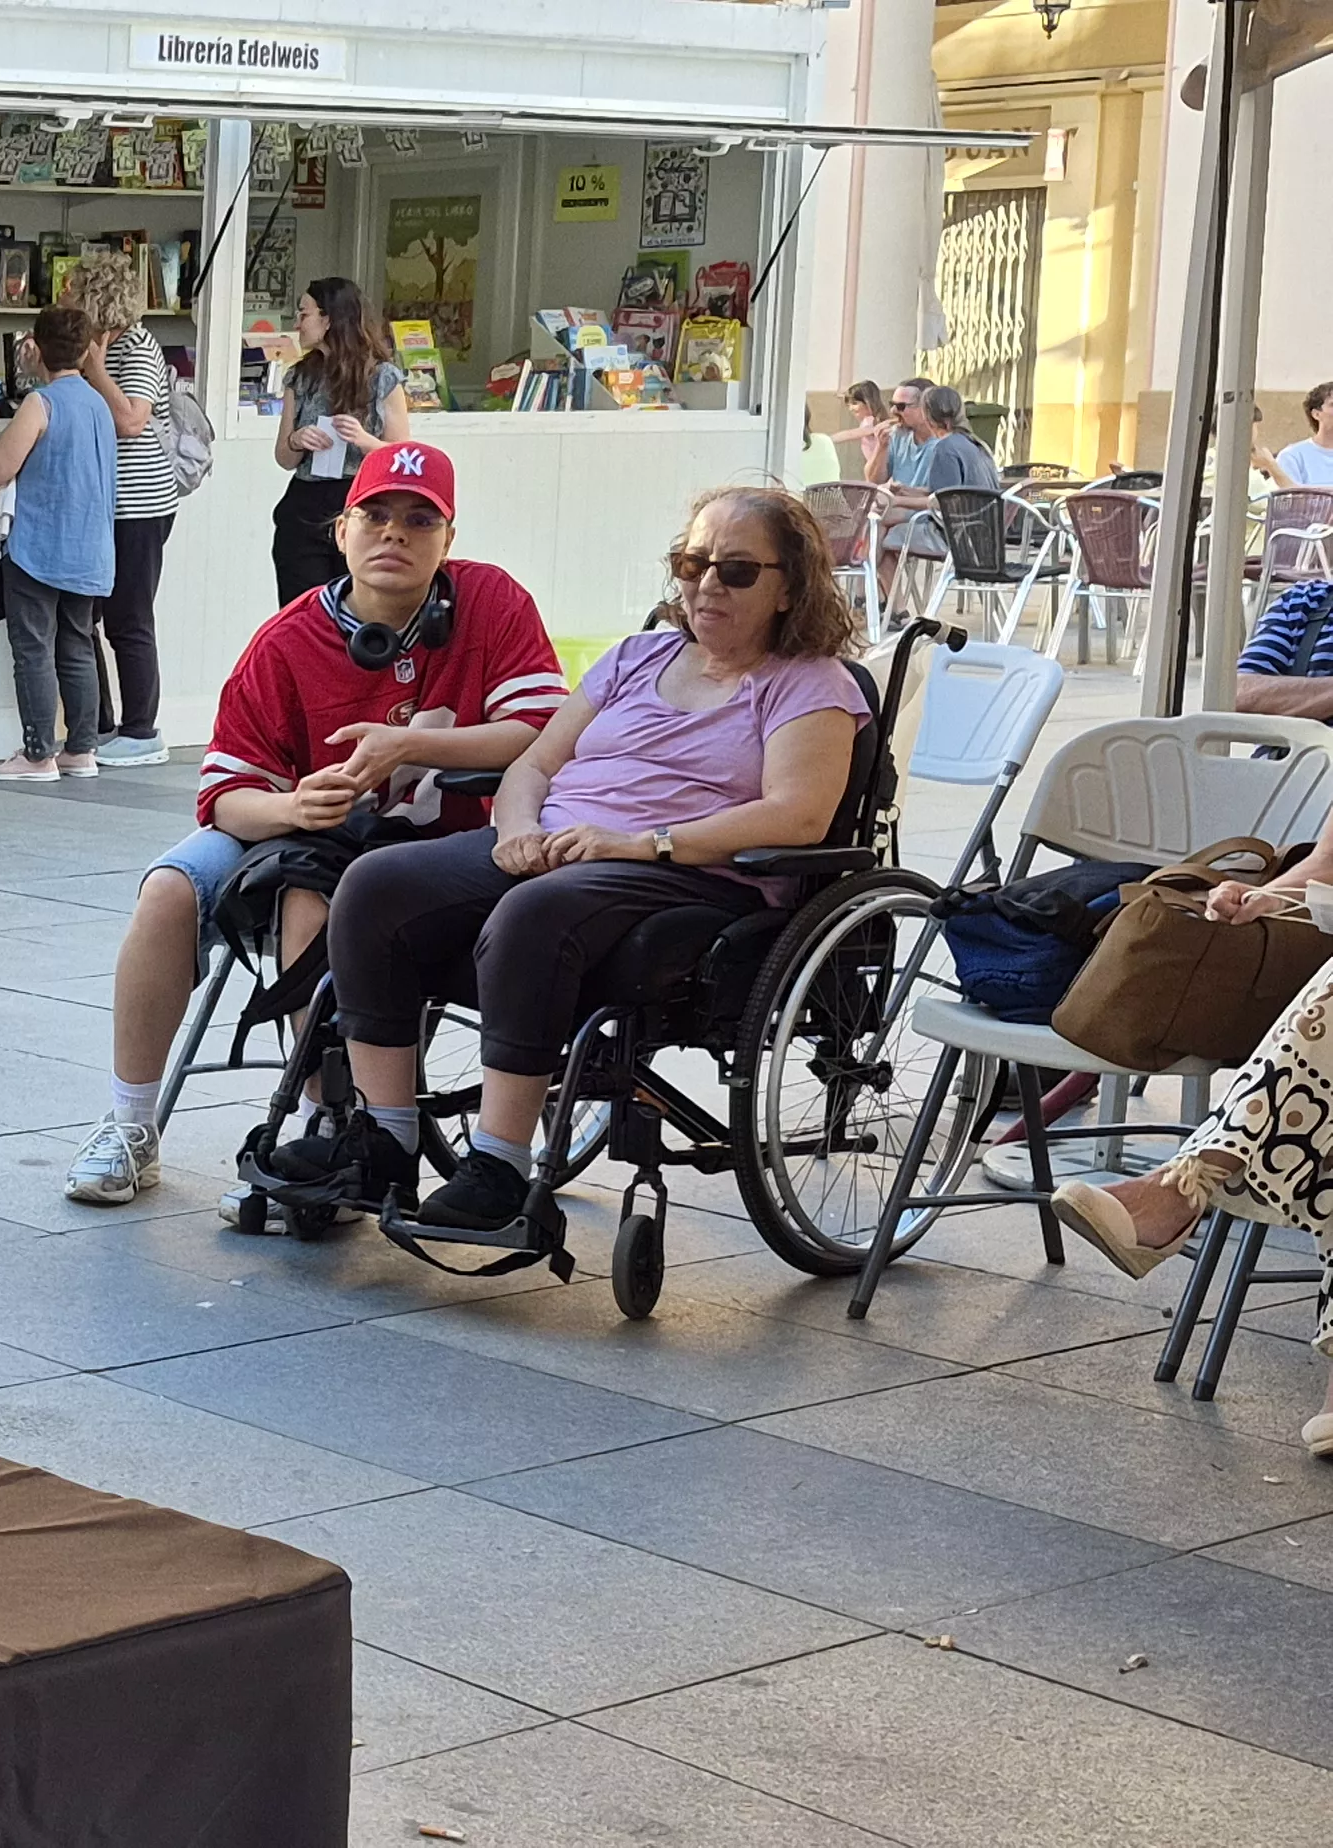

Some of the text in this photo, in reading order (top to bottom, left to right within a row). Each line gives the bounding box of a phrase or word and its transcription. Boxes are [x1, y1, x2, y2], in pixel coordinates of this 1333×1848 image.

[158, 34, 320, 70] Librería Edelweis
[568, 173, 606, 192] 10 %
